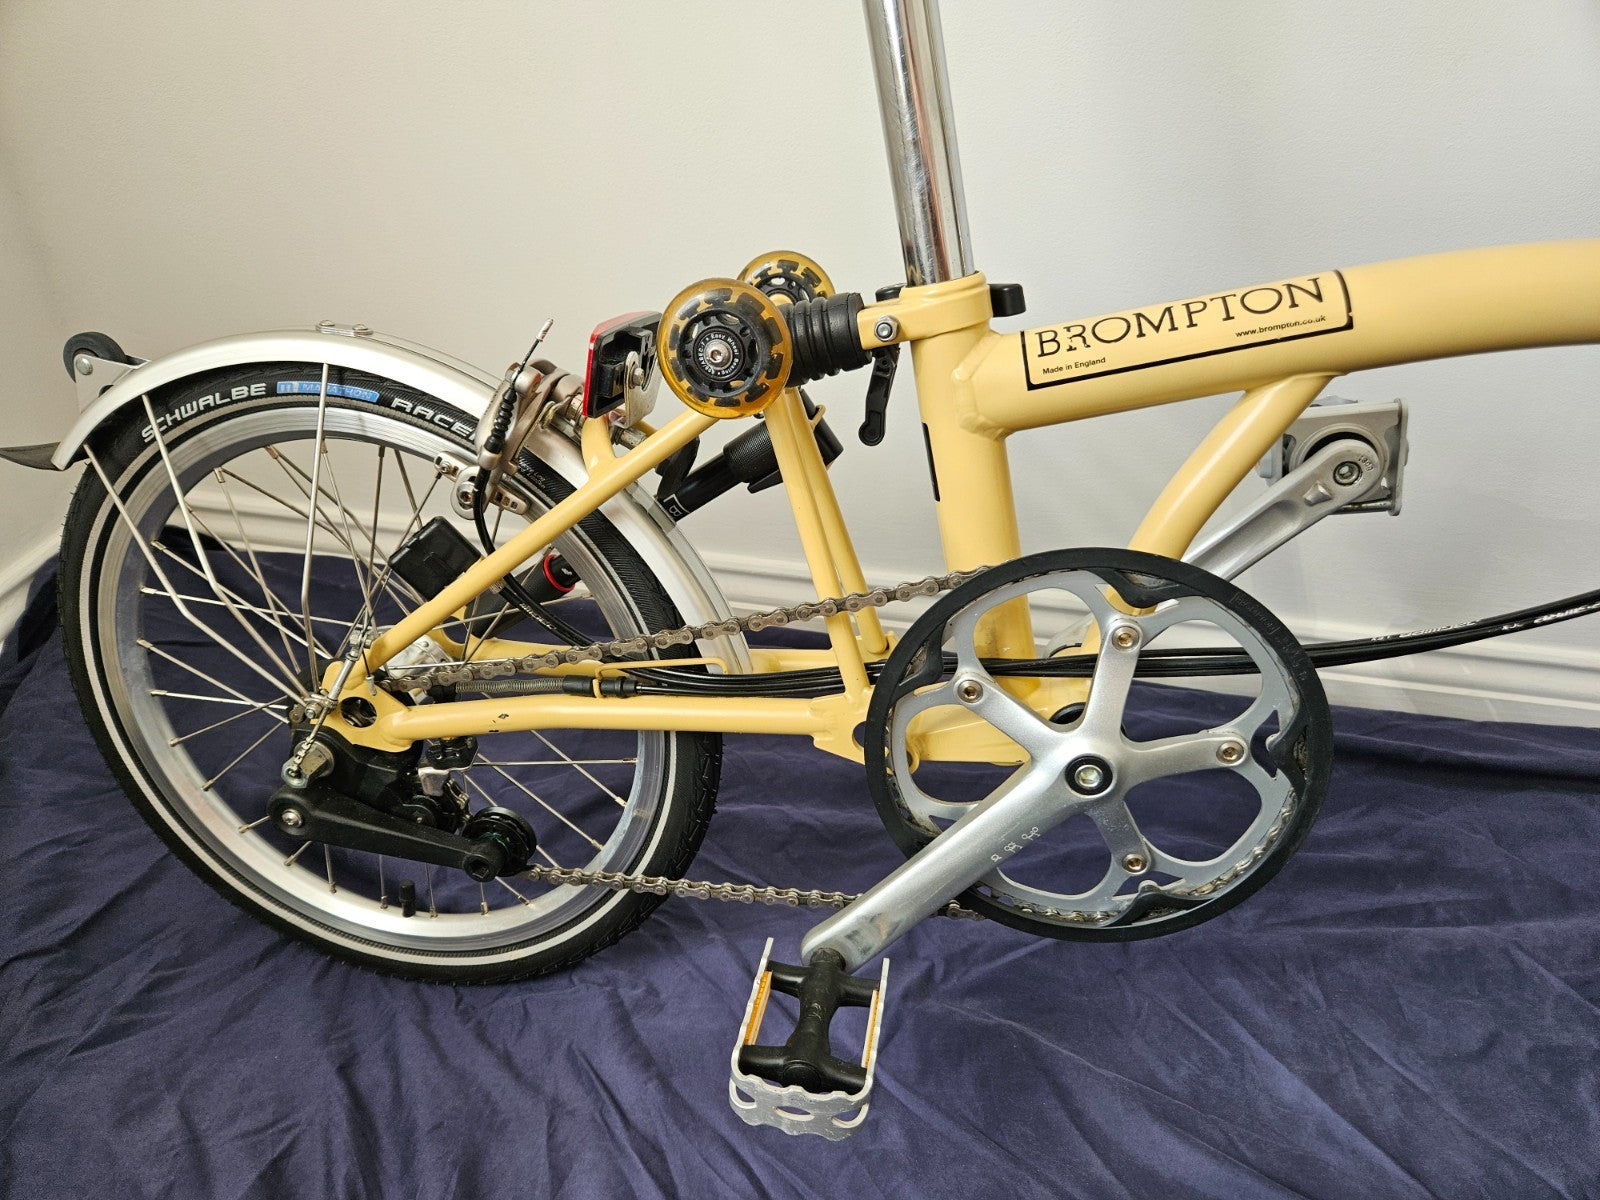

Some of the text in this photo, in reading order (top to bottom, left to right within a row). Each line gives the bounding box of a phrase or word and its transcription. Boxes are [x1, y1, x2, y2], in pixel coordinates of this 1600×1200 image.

[1035, 277, 1324, 358] BROMPTON
[1235, 314, 1326, 338] www.brompton.co.uk
[1042, 366, 1064, 375] Made
[1074, 357, 1106, 368] England
[141, 382, 267, 443] SCHWALBE
